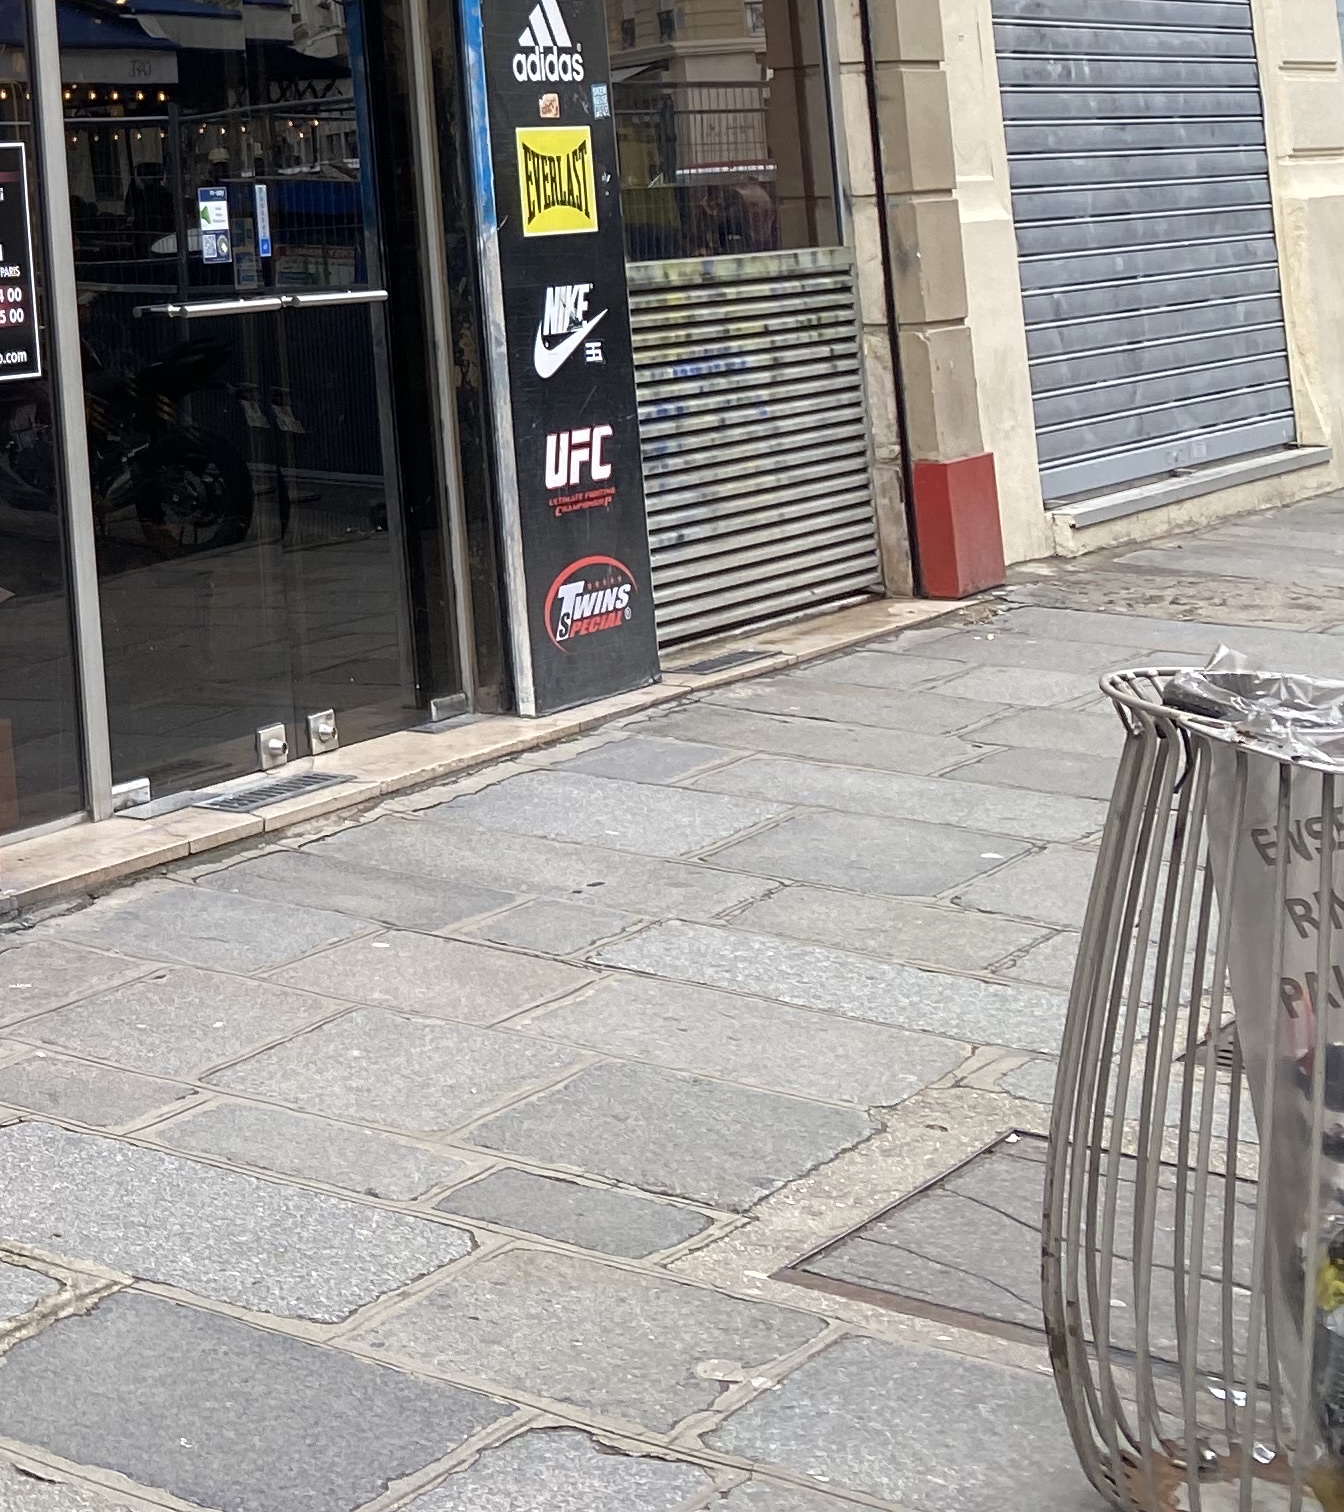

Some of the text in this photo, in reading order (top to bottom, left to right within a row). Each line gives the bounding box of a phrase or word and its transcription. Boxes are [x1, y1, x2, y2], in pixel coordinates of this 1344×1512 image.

[512, 45, 585, 83] adidas
[521, 139, 592, 226] EVERLAST
[0, 265, 21, 278] PARIS
[6, 287, 23, 303] 00
[542, 283, 590, 336] NIKE
[8, 307, 25, 324] 00
[544, 424, 613, 490] UFC
[557, 580, 632, 620] TWINS
[556, 609, 624, 642] SPECIAL
